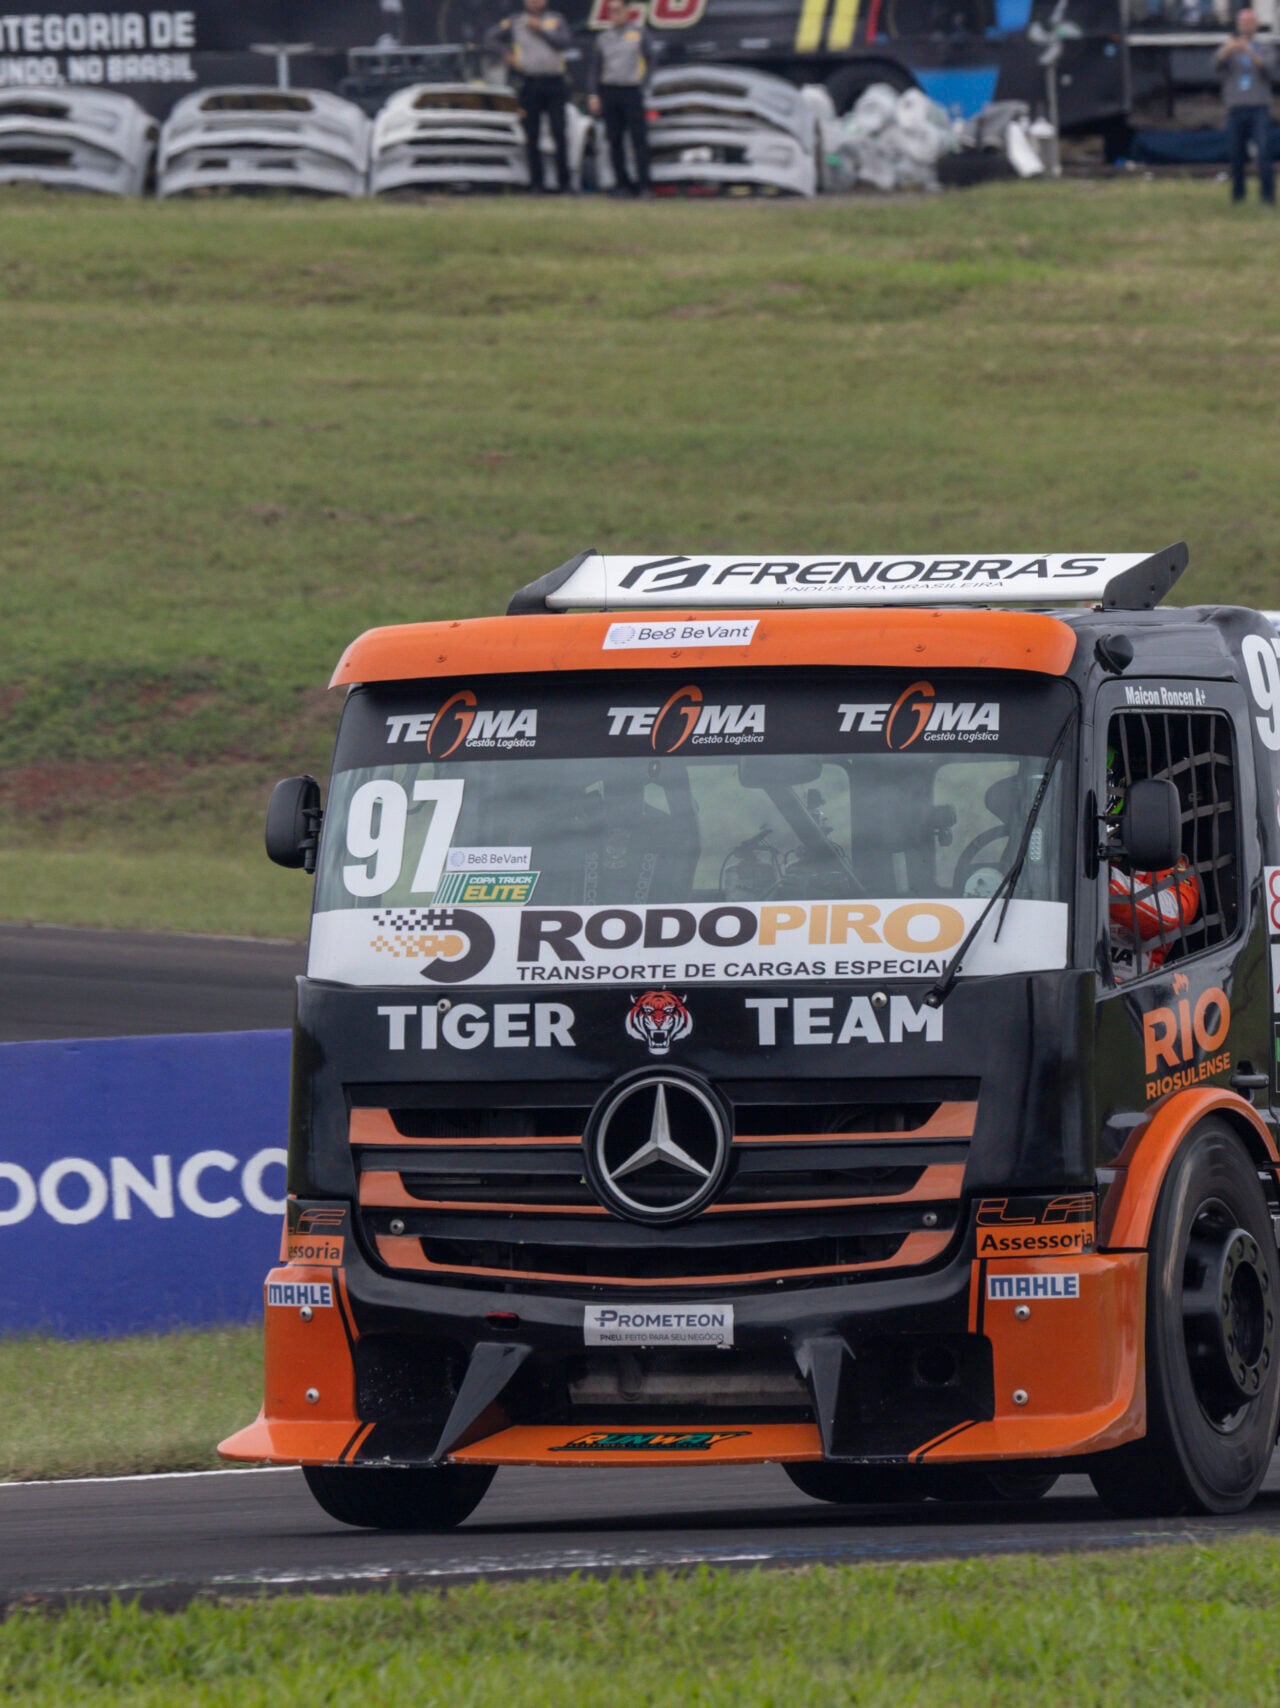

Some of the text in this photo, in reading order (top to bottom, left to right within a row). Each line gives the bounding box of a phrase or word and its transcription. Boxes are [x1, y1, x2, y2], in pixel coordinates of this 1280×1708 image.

[0, 11, 196, 52] TEGORIA DE
[67, 55, 104, 82] NO
[713, 554, 1106, 585] FRENOBRÁS
[637, 624, 751, 642] Be8 BeVant
[1125, 686, 1160, 705] Maicon
[386, 690, 537, 758] TEGMA
[606, 685, 765, 753] TEGMA
[837, 681, 1000, 750] TEGMA
[465, 737, 536, 749] Gestão Logística
[691, 733, 765, 746] Gestão Logística
[924, 731, 999, 744] Gestão Logística
[343, 779, 465, 897] 97
[467, 853, 527, 864] Be8 BeVant
[469, 875, 533, 884] COPA TRUCK
[463, 885, 529, 900] ELITE
[517, 902, 965, 962] RODOPIRO
[517, 963, 677, 982] TRANSPORTE
[685, 963, 716, 980] DE
[723, 960, 827, 978] CARGAS
[377, 996, 944, 1050] TIGER TEAM
[1143, 987, 1231, 1076] RIO
[1146, 1052, 1231, 1100] RIOSULENSE
[980, 1229, 1093, 1251] Assessoria
[269, 1283, 331, 1305] MAHLE
[990, 1276, 1077, 1297] MAHLE
[594, 1310, 725, 1327] PROMETEON
[625, 1333, 647, 1341] FEITO
[649, 1333, 669, 1341] PARA
[671, 1333, 686, 1341] SEU
